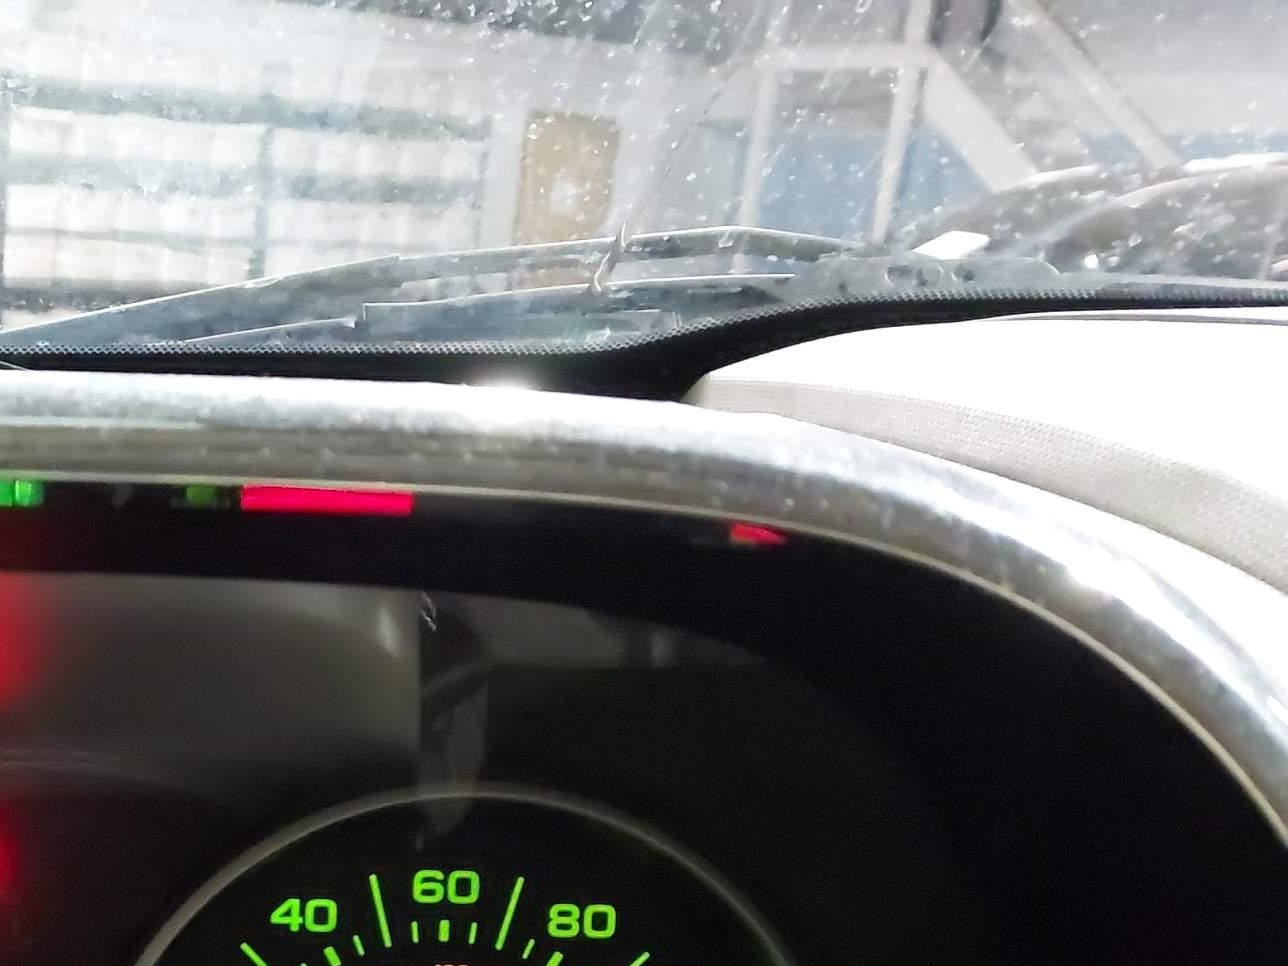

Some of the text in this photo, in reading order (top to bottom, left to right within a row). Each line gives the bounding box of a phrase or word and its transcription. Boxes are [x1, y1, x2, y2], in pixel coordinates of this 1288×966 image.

[413, 870, 479, 904] 60
[270, 899, 337, 932] 40
[548, 904, 616, 938] 80
